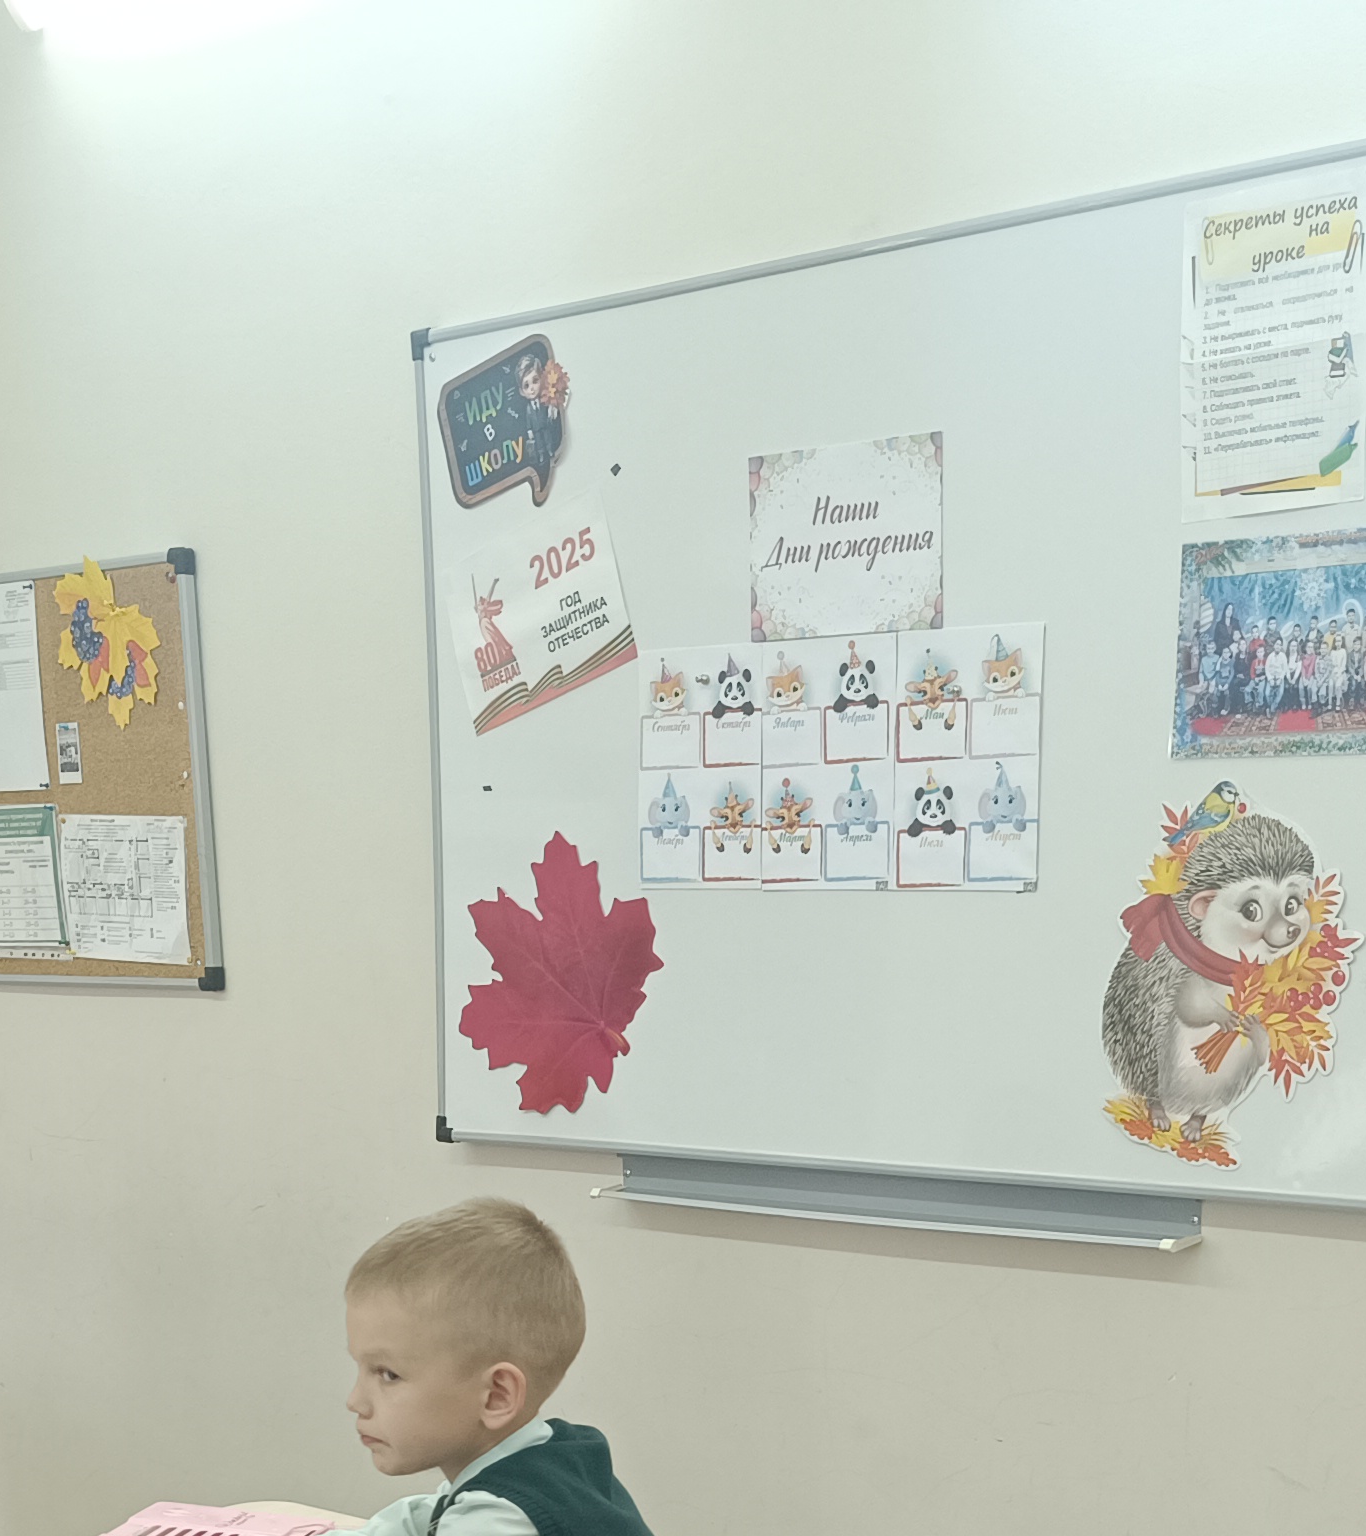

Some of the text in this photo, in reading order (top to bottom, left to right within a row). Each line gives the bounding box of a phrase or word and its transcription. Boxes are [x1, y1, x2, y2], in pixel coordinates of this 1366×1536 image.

[1203, 196, 1358, 240] Секреты успеха
[1308, 220, 1330, 237] на
[1251, 244, 1306, 273] уроке
[464, 382, 504, 426] ИДУ
[465, 436, 524, 487] ШКОЛУ
[812, 494, 880, 526] Наши
[529, 526, 596, 590] 2025
[760, 530, 934, 573] Дни рождения
[540, 595, 608, 639] ЗАЩИТНИКА
[559, 590, 582, 612] ГОД
[547, 613, 610, 653] ОТЕЧЕСТВА
[481, 662, 522, 692] ПОБЕДА!
